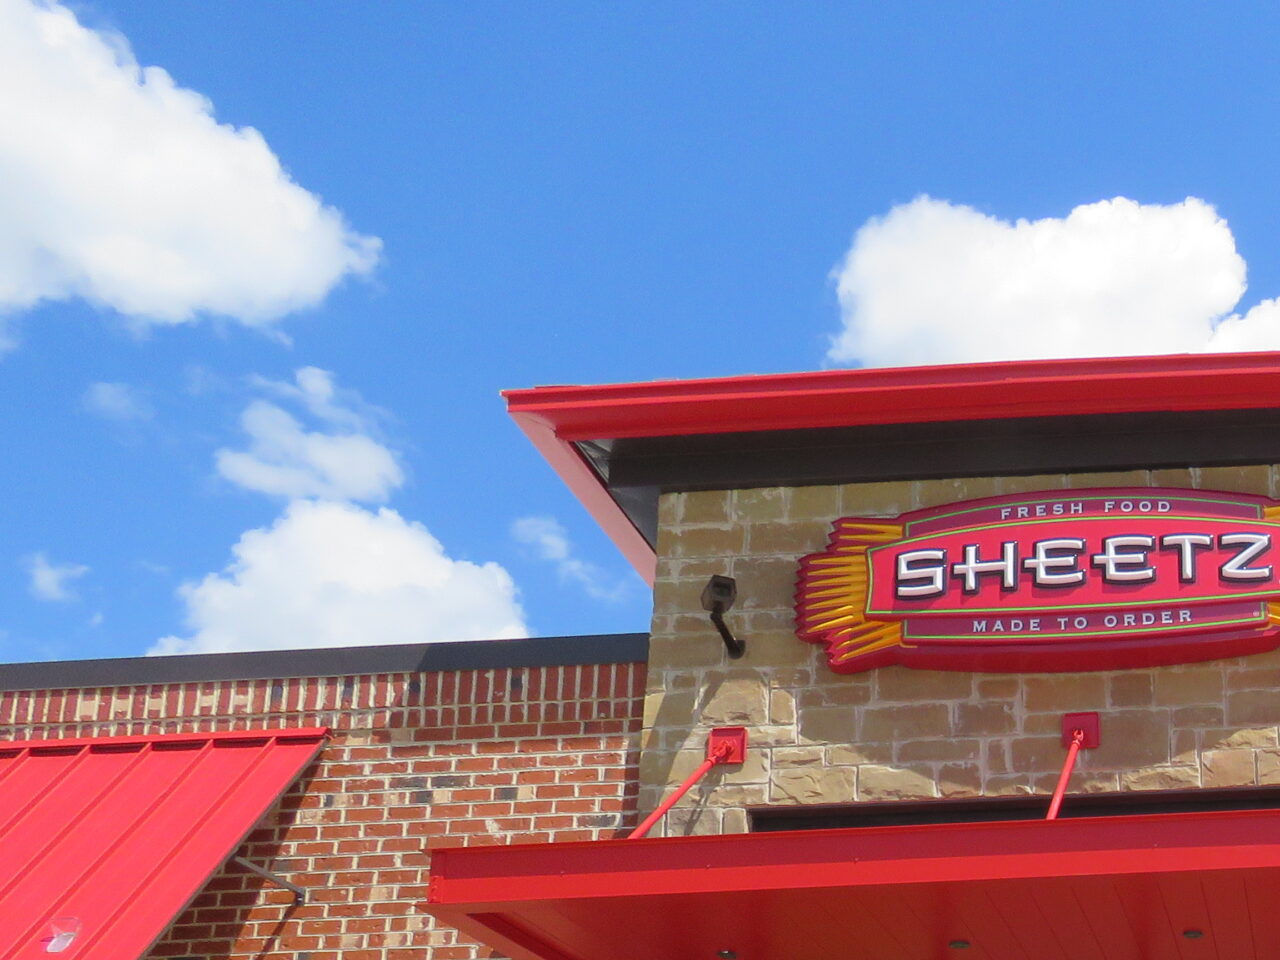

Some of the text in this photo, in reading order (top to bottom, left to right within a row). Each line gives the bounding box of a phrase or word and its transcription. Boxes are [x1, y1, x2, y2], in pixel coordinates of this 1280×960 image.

[1000, 500, 1172, 521] FRESH FOOD
[896, 533, 1275, 598] SHEETZ
[972, 609, 1193, 634] MADE TO ORDER
